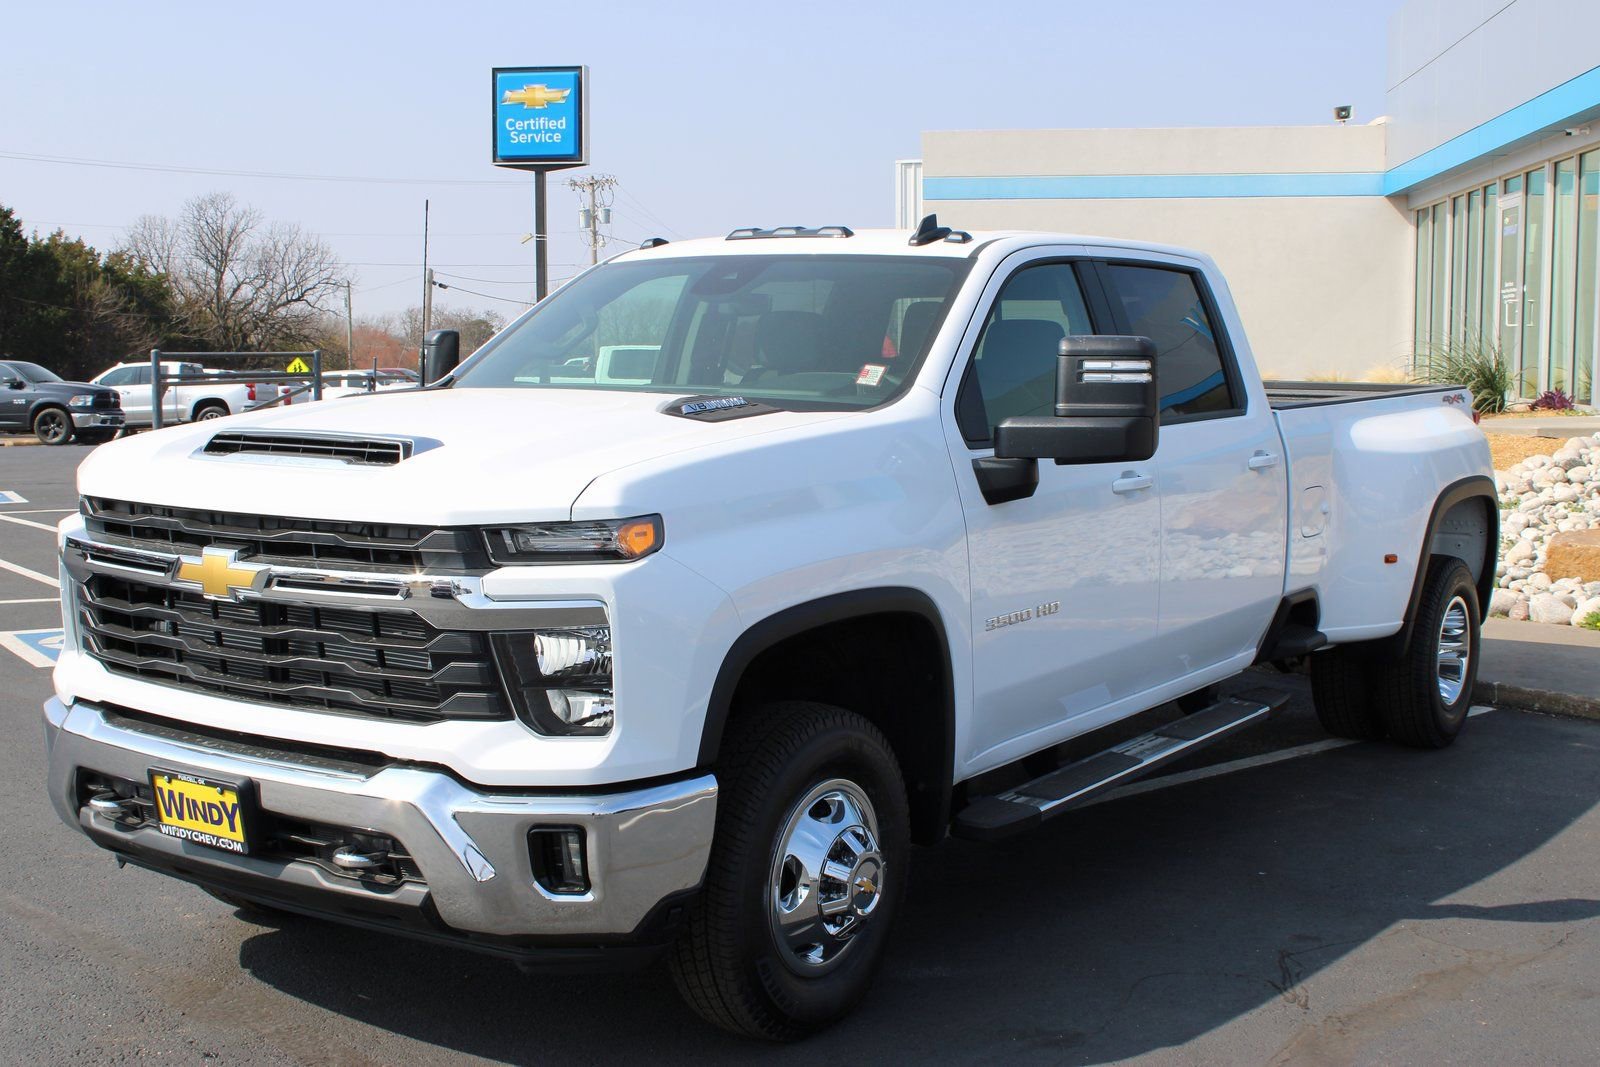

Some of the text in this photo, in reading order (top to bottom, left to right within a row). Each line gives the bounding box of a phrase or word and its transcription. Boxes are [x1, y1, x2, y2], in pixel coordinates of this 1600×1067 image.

[505, 116, 566, 130] Certified
[510, 131, 561, 143] Service
[985, 601, 1060, 631] 3500 HD
[160, 824, 243, 852] WINDYCHEV.COM
